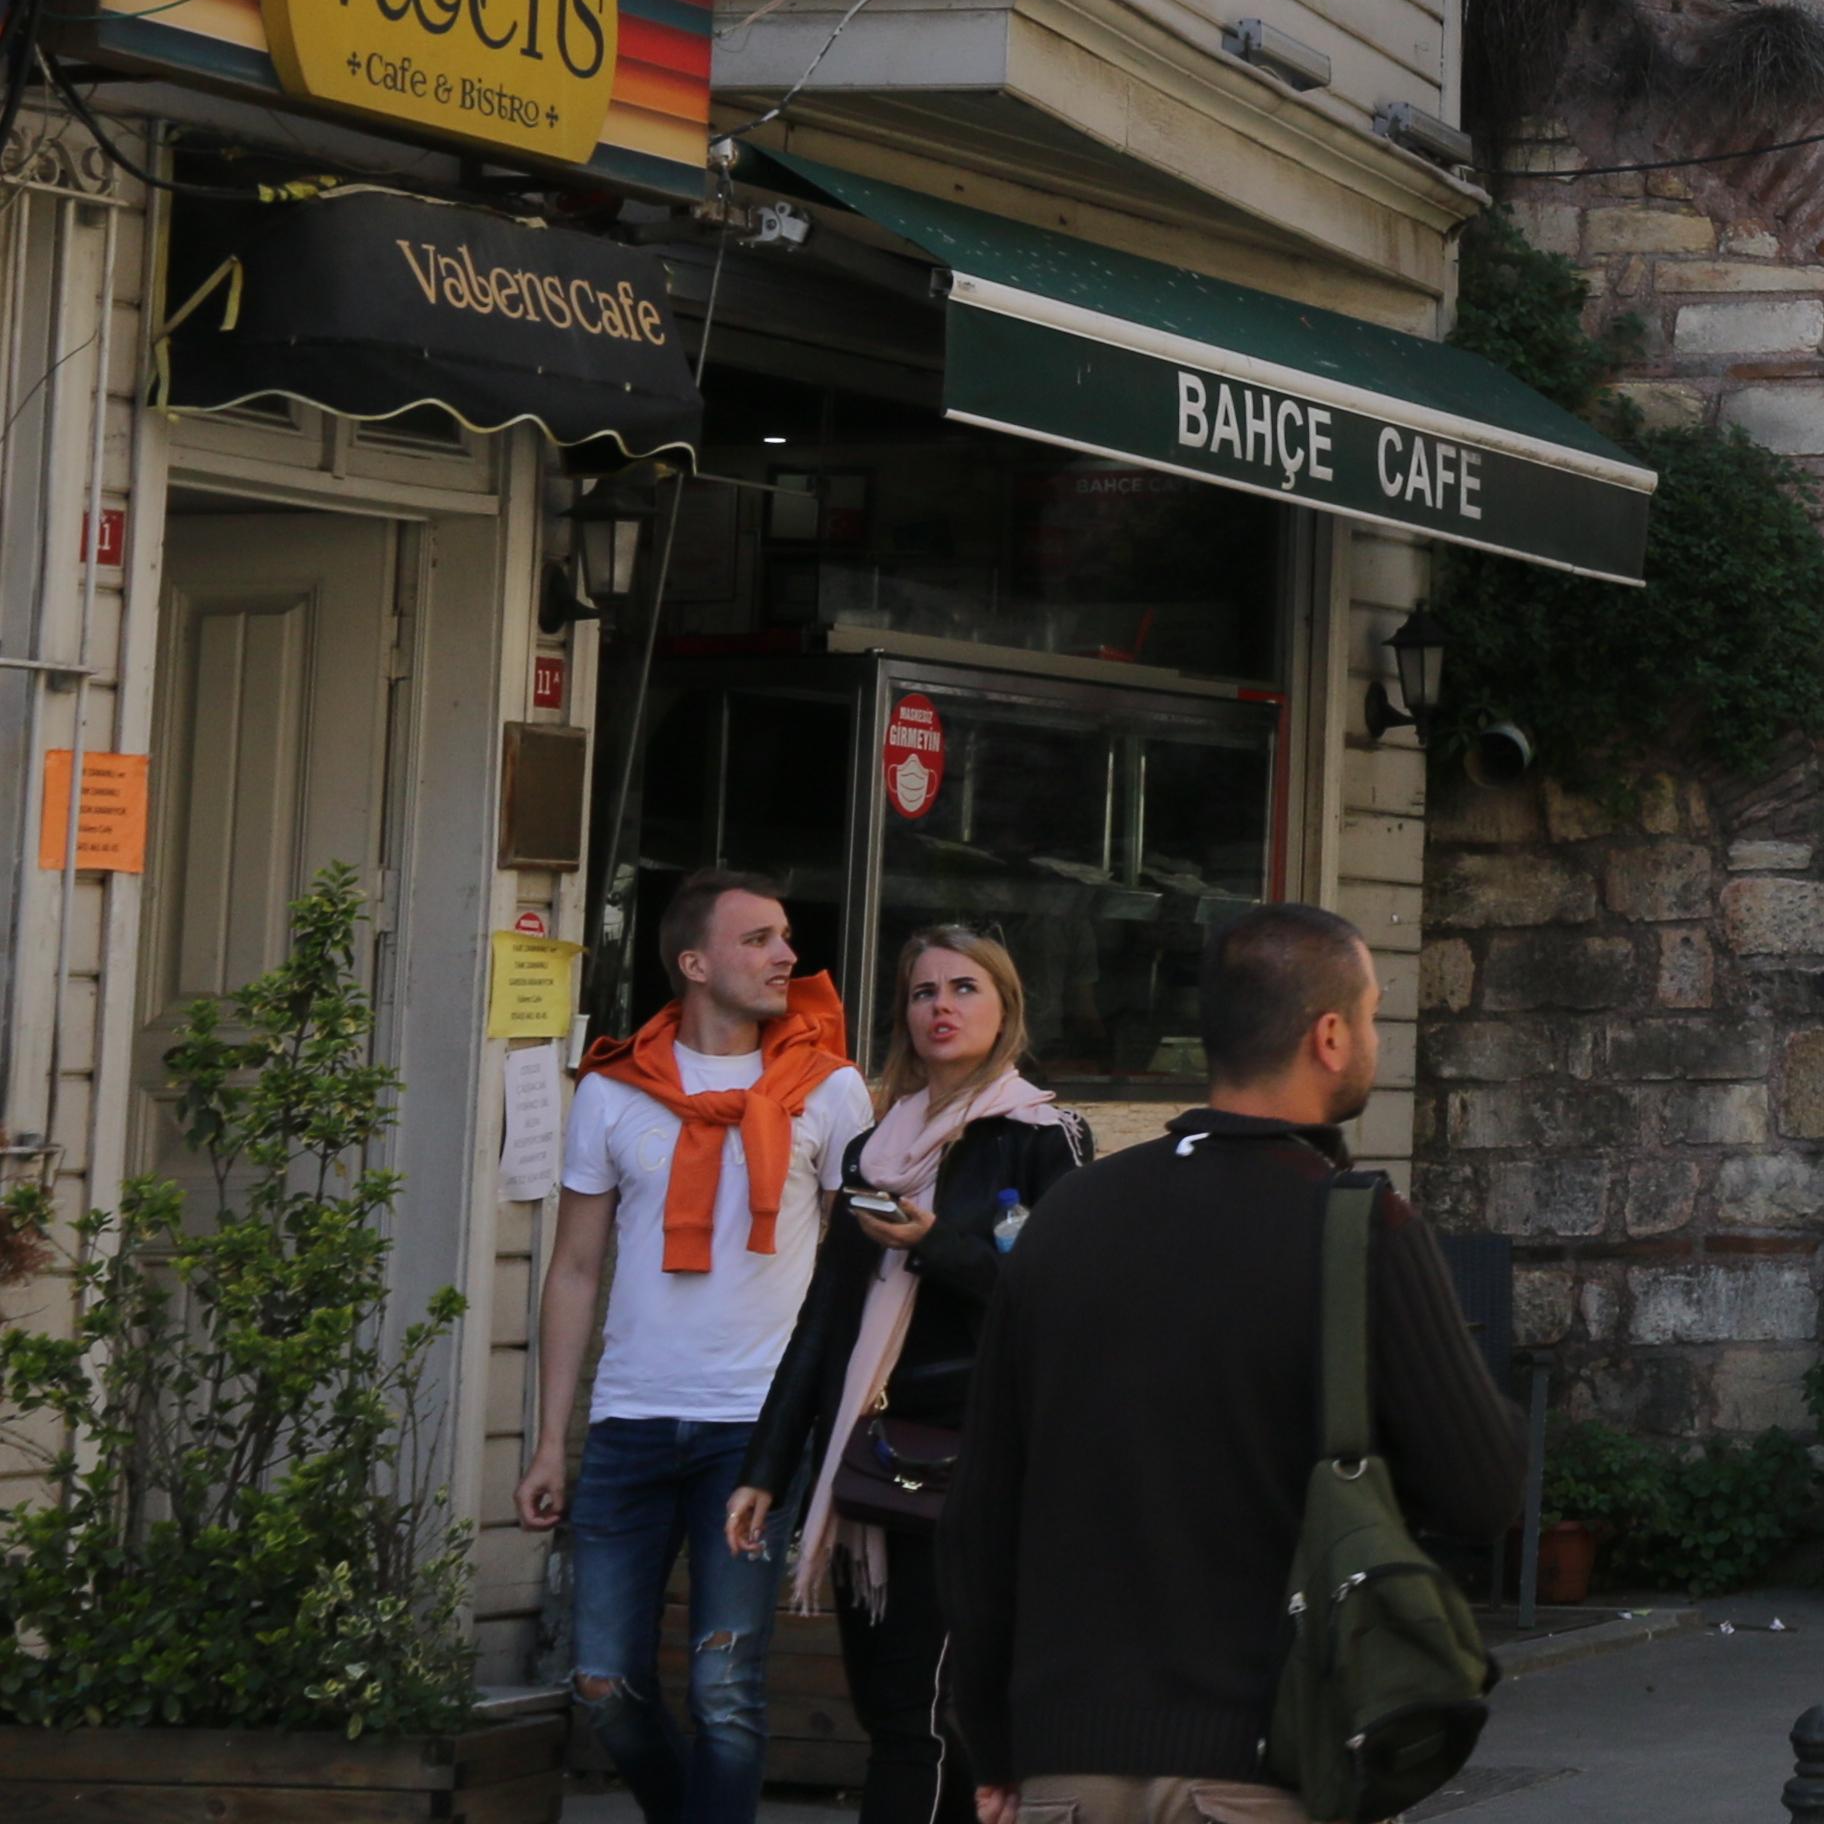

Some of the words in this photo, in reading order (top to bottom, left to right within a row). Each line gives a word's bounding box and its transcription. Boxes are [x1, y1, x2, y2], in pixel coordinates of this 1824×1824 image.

[365, 52, 427, 97] Cafe
[434, 74, 453, 104] &
[1178, 370, 1334, 491] BAHÇE
[1377, 426, 1482, 519] CAFE
[889, 720, 941, 753] GİRMEYİN
